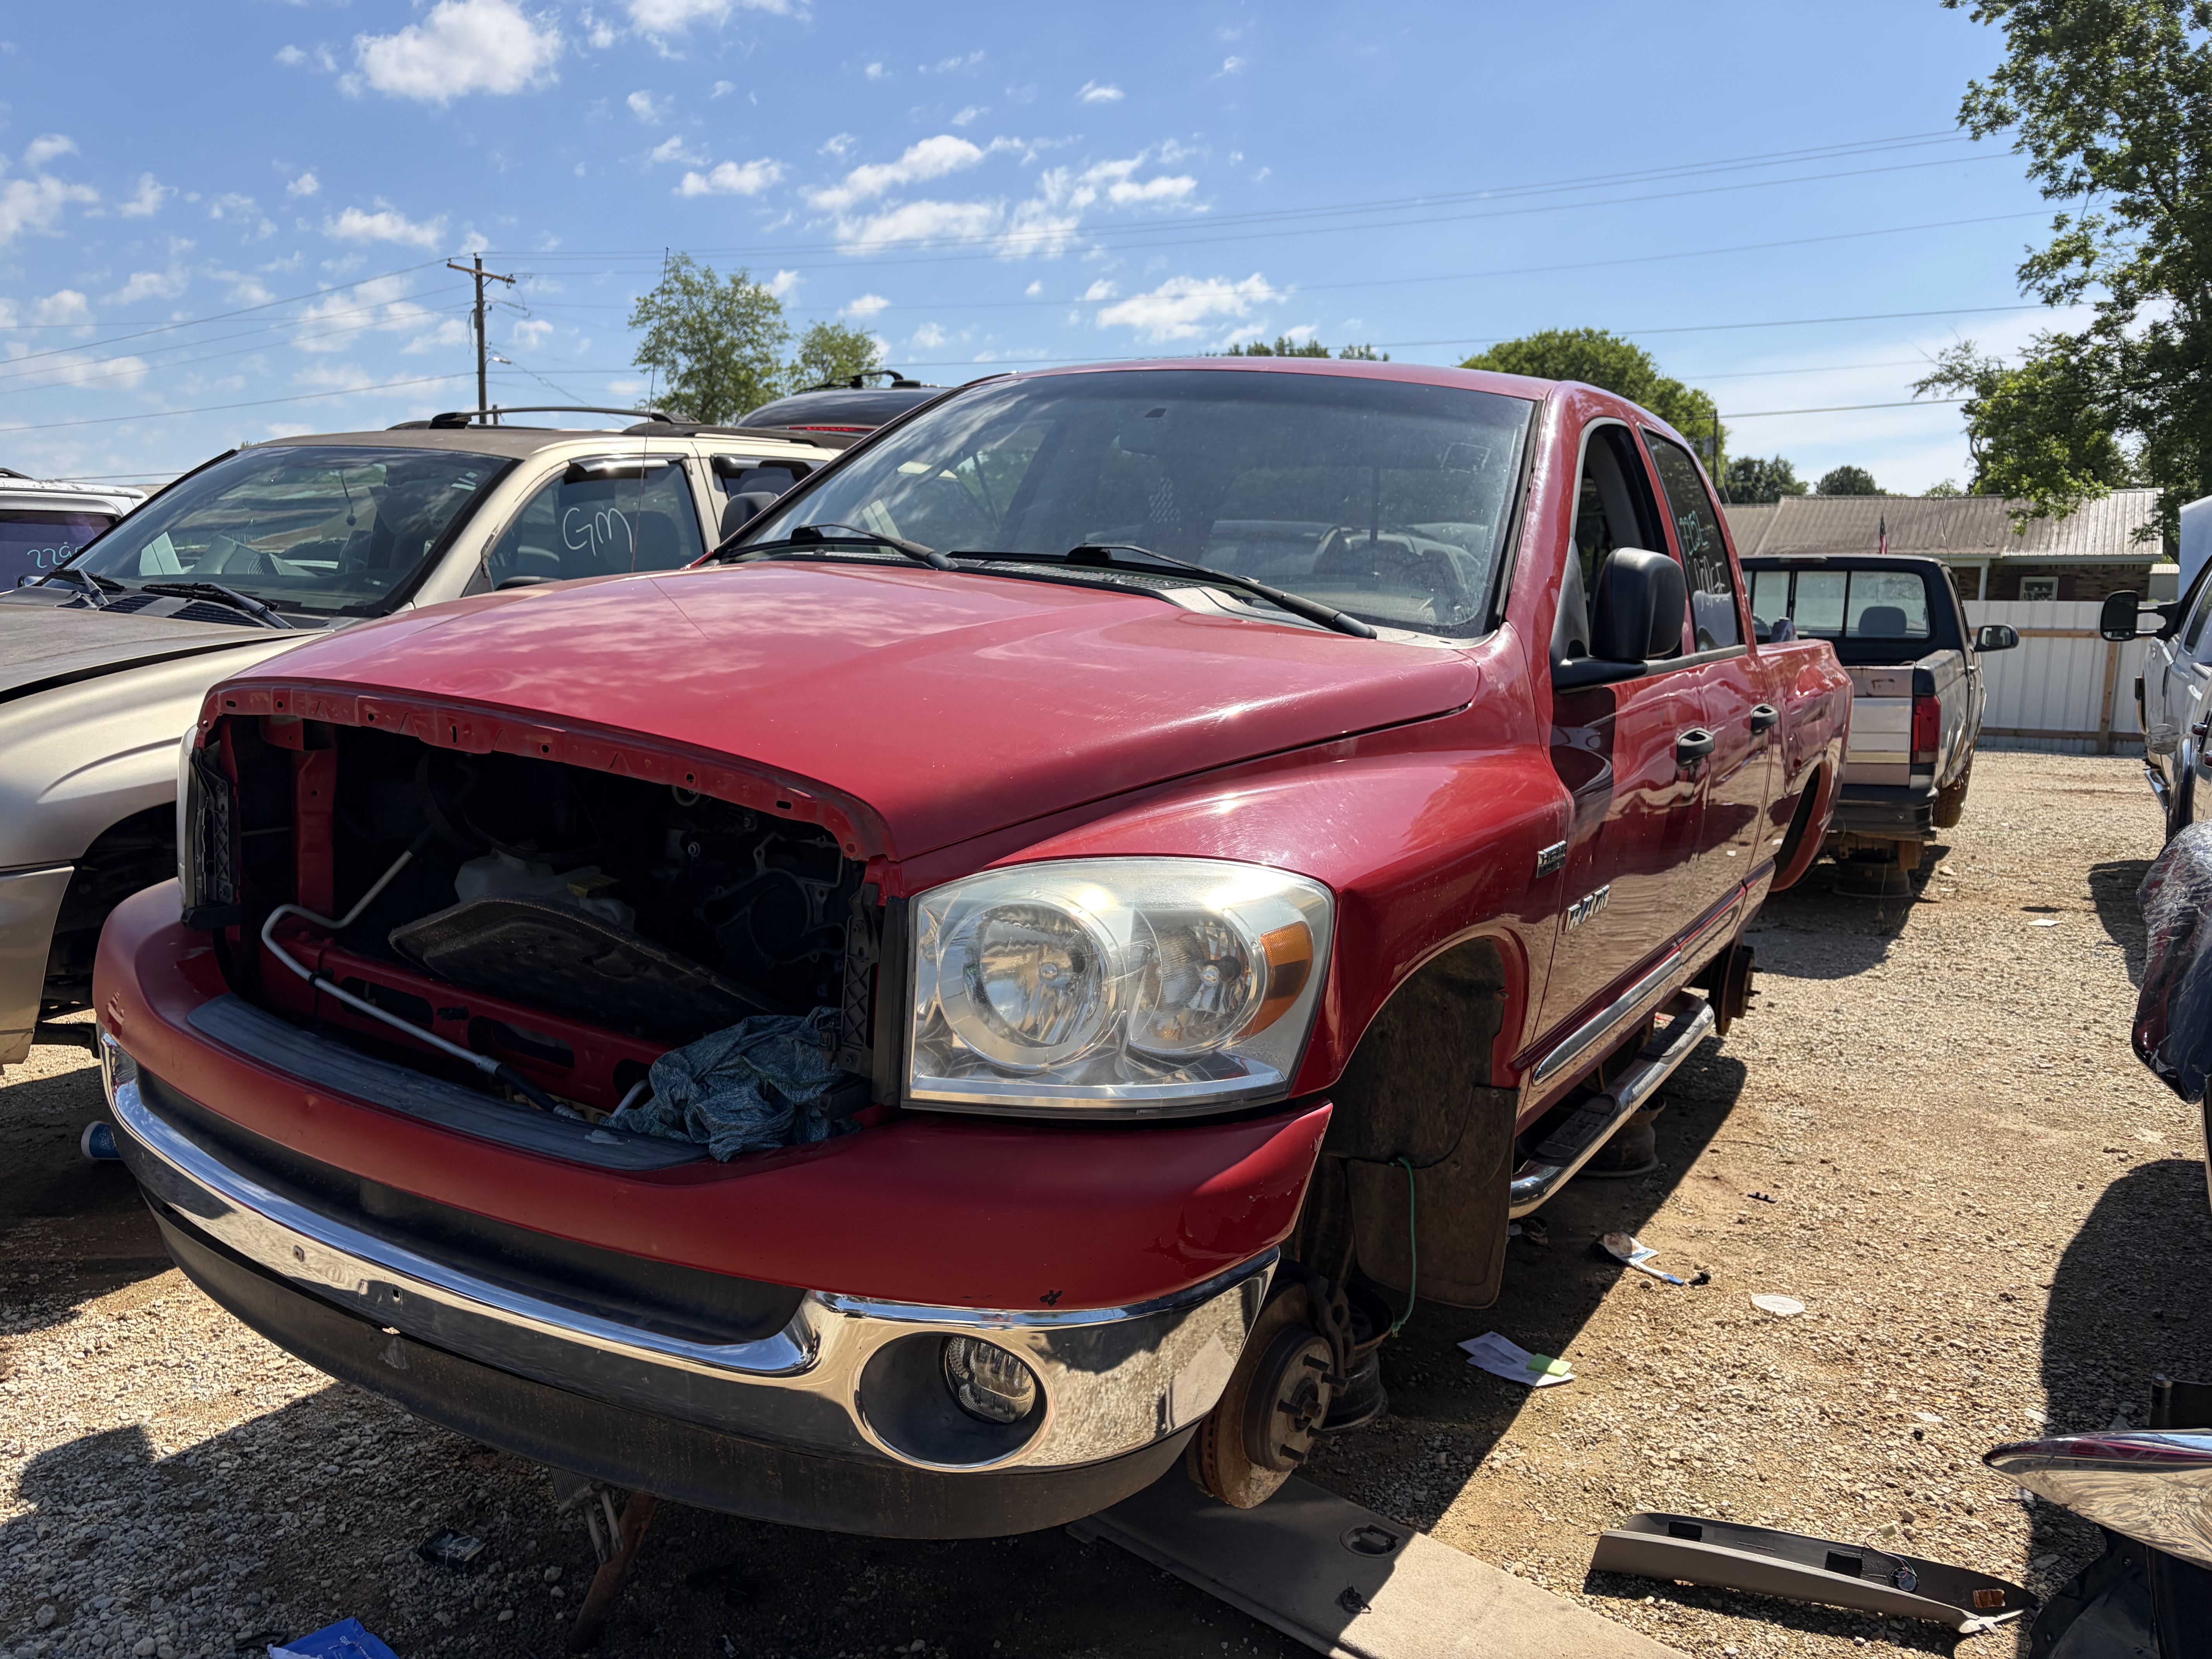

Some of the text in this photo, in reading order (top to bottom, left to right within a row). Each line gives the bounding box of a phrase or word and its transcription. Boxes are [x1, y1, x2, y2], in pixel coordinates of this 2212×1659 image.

[563, 507, 632, 556] GM
[1679, 510, 1709, 556] 2252
[1564, 884, 1610, 932] RAM
